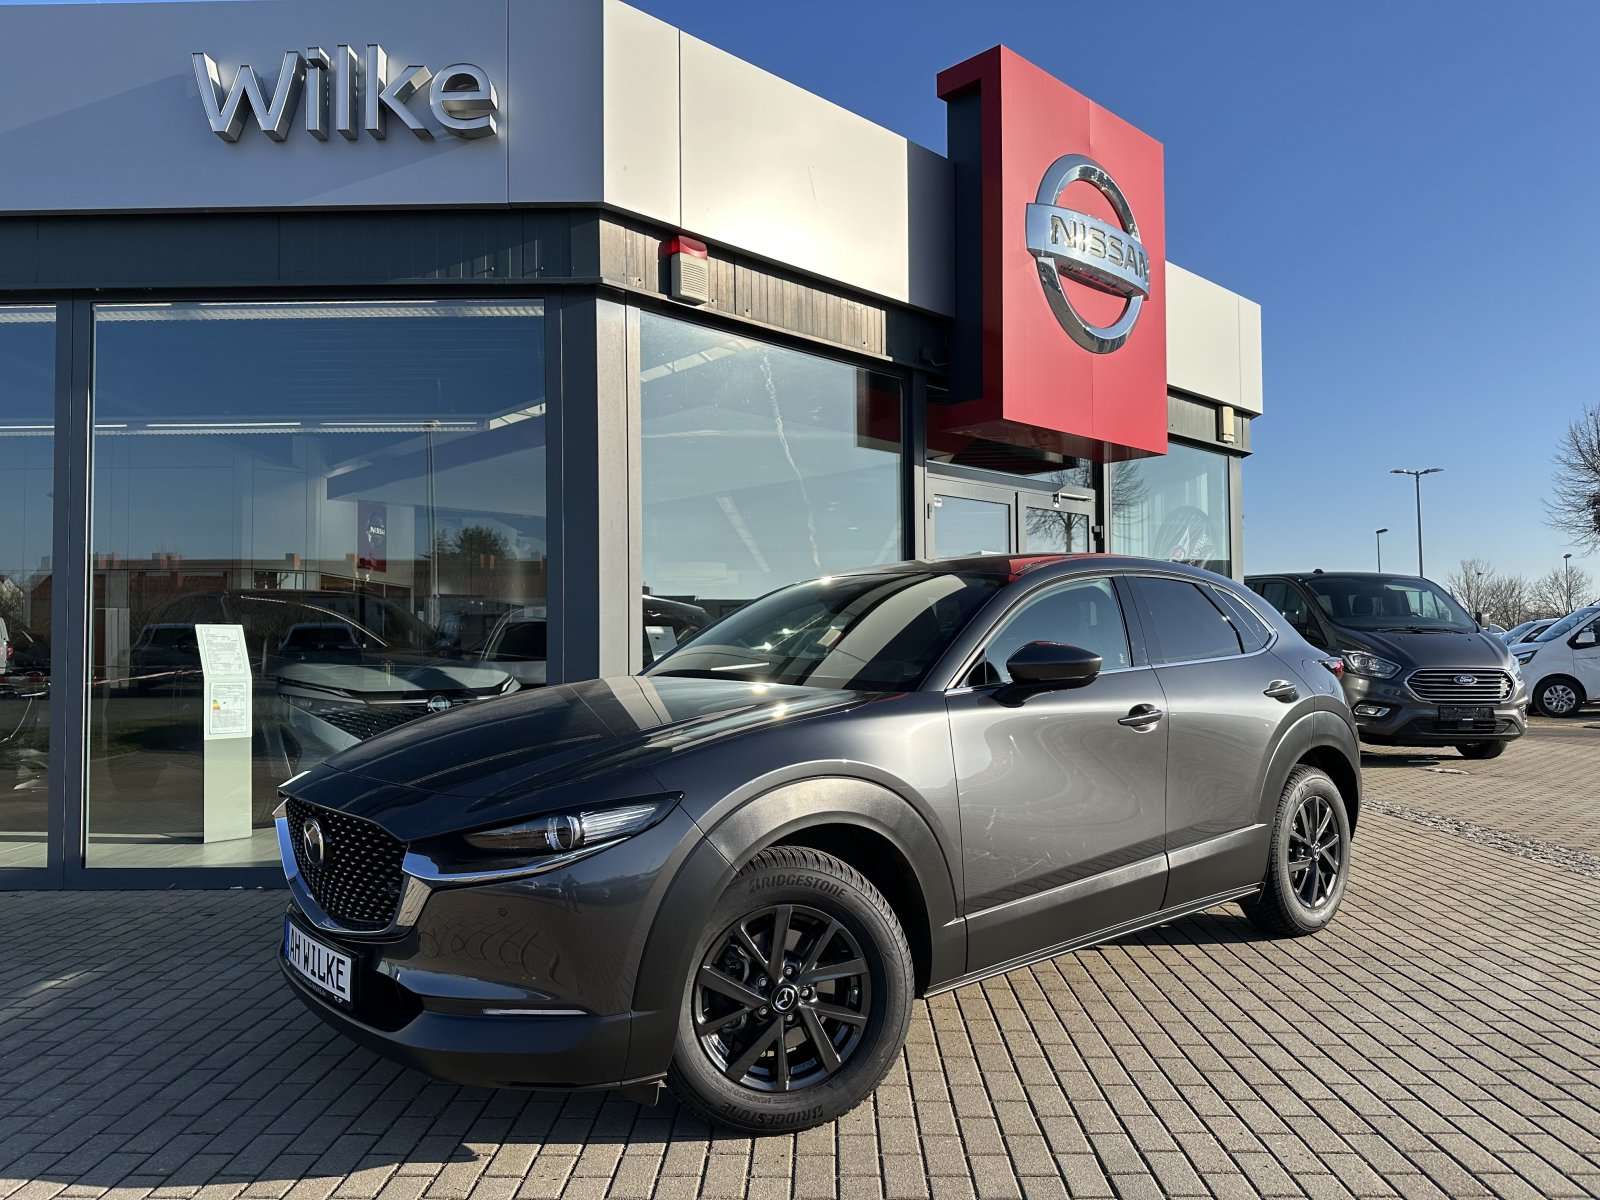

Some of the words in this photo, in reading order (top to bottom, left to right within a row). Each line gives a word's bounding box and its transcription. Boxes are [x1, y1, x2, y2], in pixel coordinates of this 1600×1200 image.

[192, 44, 498, 143] Wilke
[1051, 214, 1147, 278] NISSAN
[750, 874, 848, 898] BRIDGESTONE
[290, 928, 301, 966] AH
[303, 938, 346, 994] WILKE
[720, 1102, 824, 1124] BRIDGESTONE
